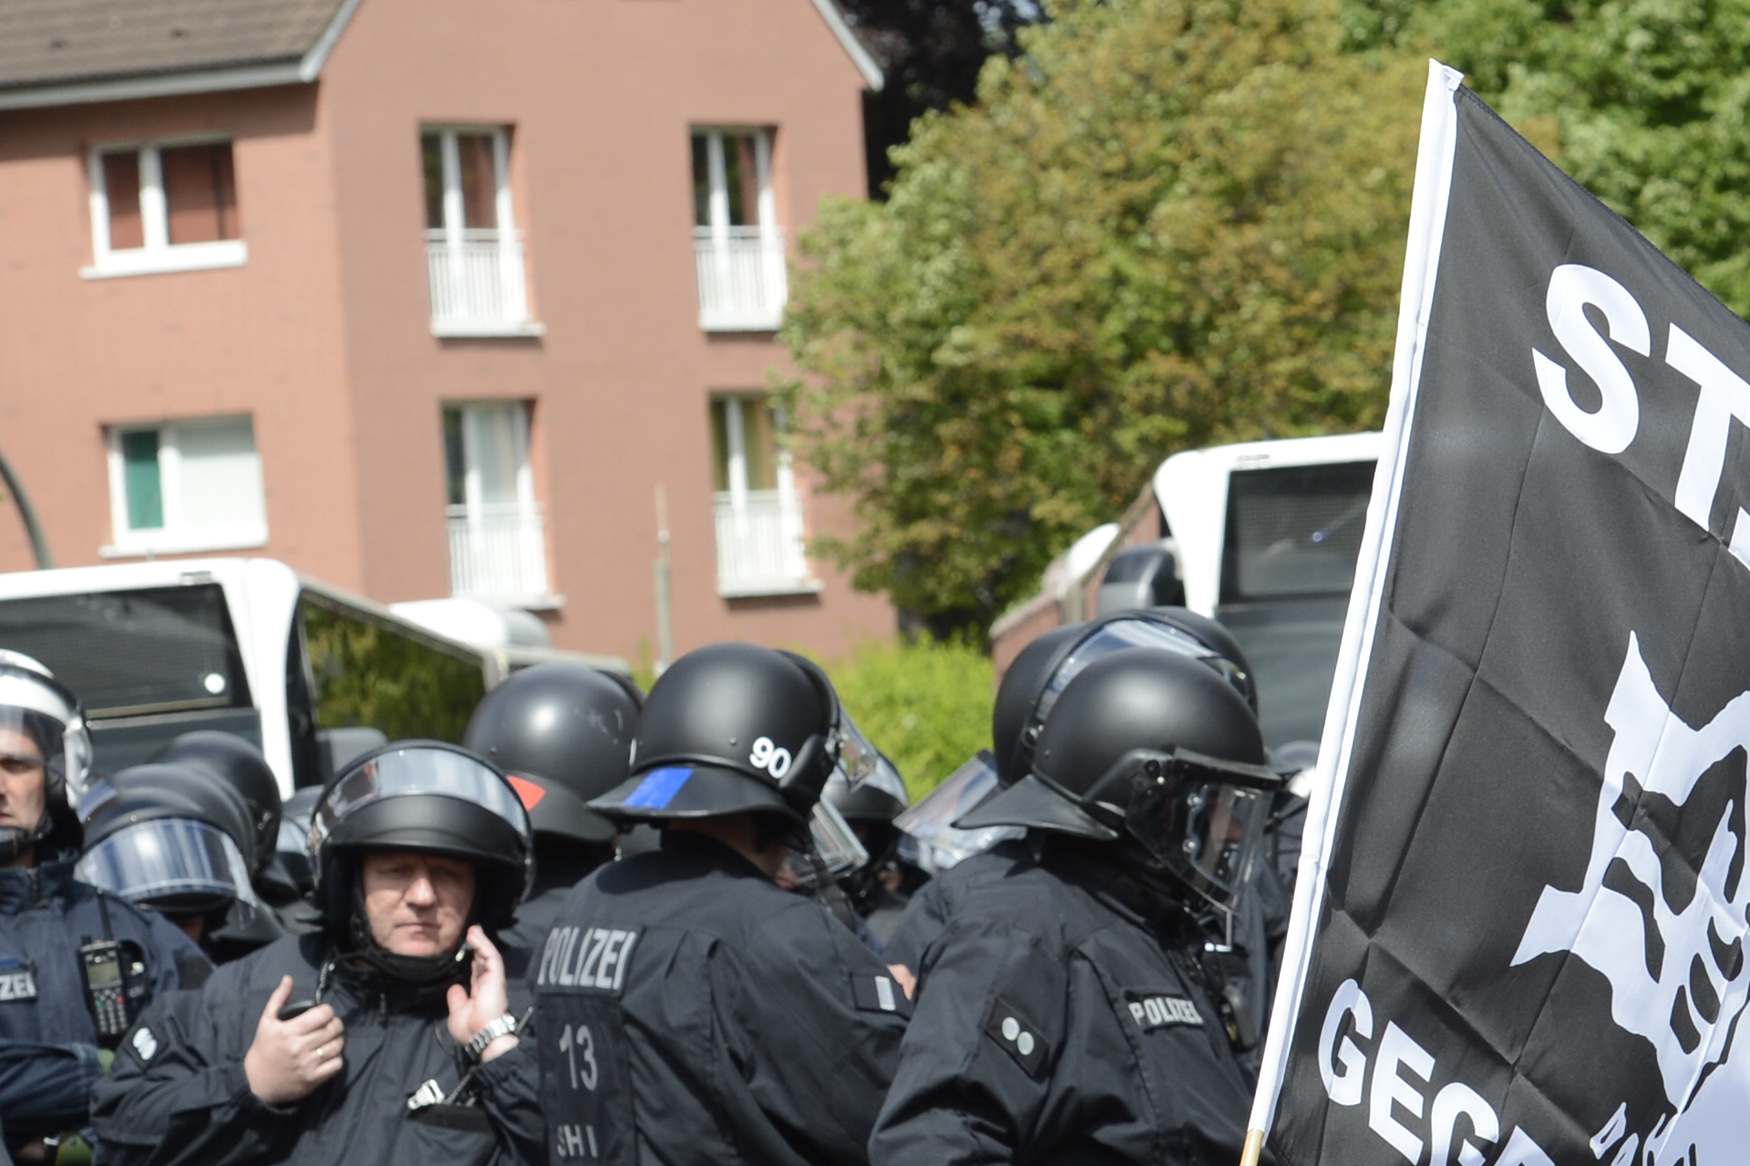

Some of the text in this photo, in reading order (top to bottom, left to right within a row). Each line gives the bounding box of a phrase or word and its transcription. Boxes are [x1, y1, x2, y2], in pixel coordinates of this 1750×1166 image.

[749, 736, 792, 779] 90
[537, 926, 637, 990] POLIZEI
[1128, 997, 1203, 1025] POLIZEI
[559, 1024, 598, 1091] 13
